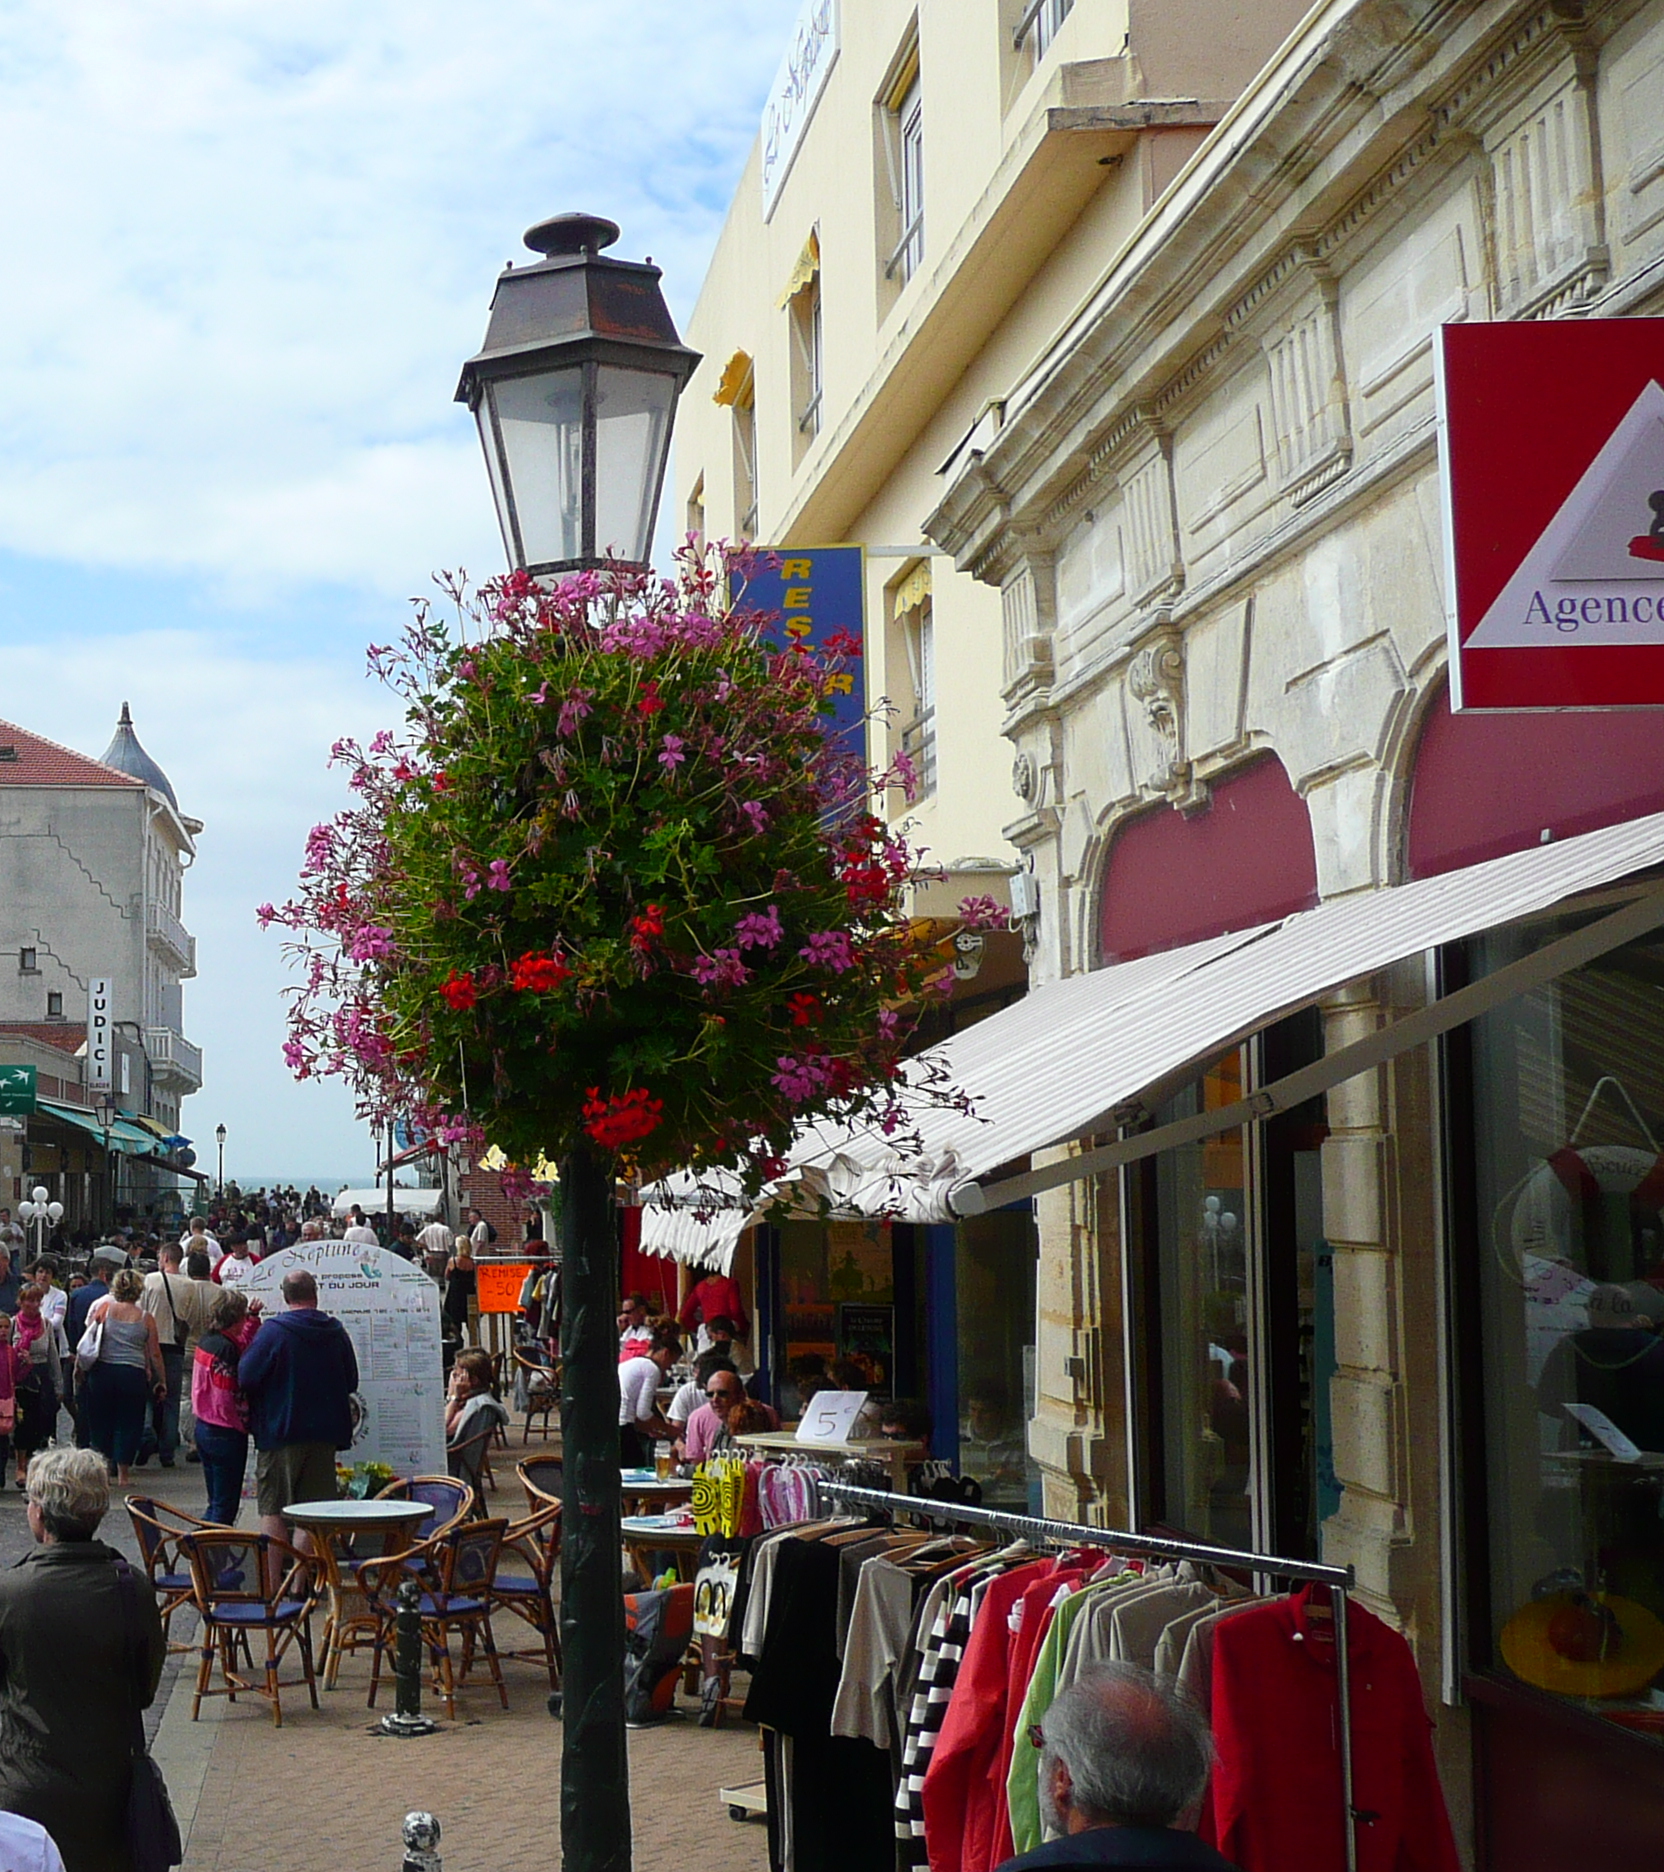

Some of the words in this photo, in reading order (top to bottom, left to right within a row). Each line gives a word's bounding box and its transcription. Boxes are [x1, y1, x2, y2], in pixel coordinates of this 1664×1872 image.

[93, 982, 107, 1078] JUDICI
[282, 1243, 361, 1268] Neptune
[479, 1267, 524, 1280] REMISE
[348, 1281, 380, 1289] JOUR
